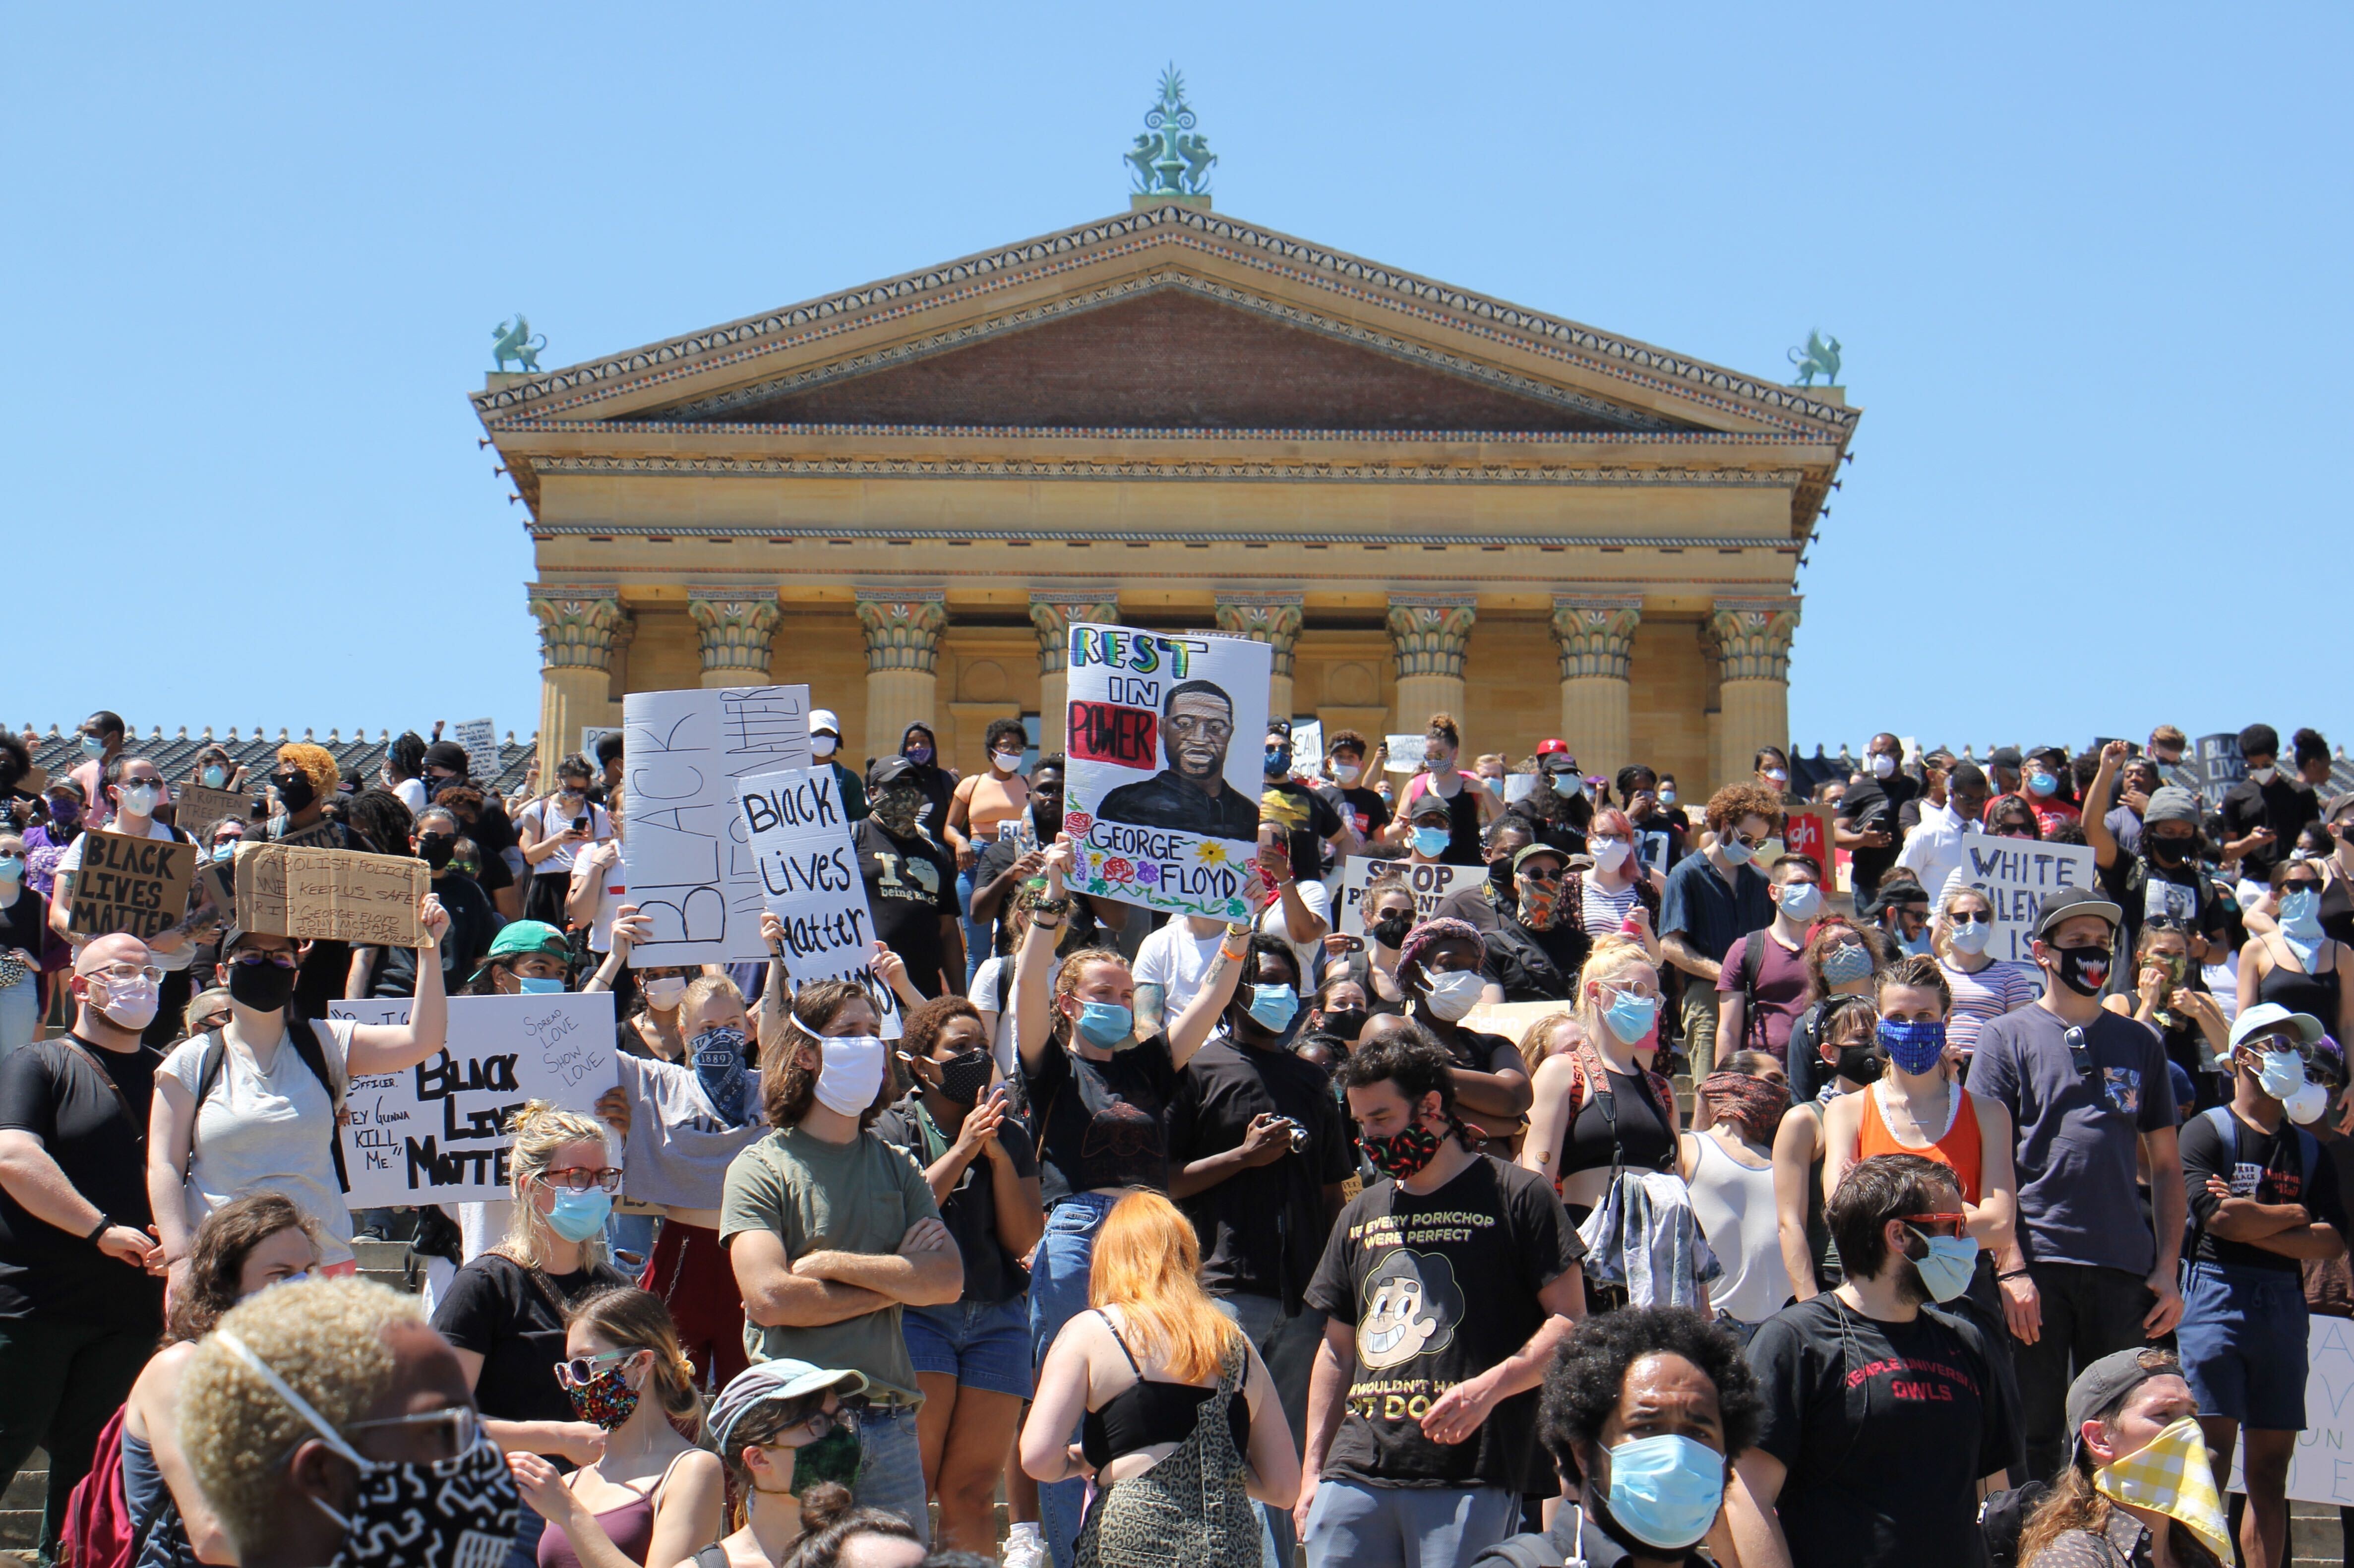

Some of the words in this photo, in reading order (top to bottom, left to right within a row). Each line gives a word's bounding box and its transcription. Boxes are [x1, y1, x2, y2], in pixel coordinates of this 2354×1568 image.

[1071, 627, 1208, 679] REST
[1108, 676, 1159, 707] IN
[1069, 701, 1153, 762] POWER
[2205, 737, 2243, 760] BLA
[2207, 758, 2247, 781] LIVE
[182, 788, 191, 801] A
[196, 791, 242, 808] ROTTEN
[182, 803, 214, 819] TREE
[744, 777, 838, 834] Black
[631, 713, 725, 950] BLACK
[1090, 822, 1184, 861] GEORGE
[86, 835, 176, 880] BLACK
[260, 851, 351, 873] ABOLISH
[358, 860, 414, 881] POLICE
[1969, 847, 2078, 887] WHITE
[79, 871, 163, 909] LIVES
[256, 876, 288, 897] WE
[300, 881, 339, 896] KEEP
[343, 886, 365, 896] US
[880, 887, 913, 901] being
[1160, 864, 1236, 899] FLOYD
[300, 905, 355, 919] GEORGE
[360, 912, 399, 926] FLOYD
[1970, 883, 2046, 923] ILEN
[297, 918, 334, 930] TONY
[297, 926, 365, 939] BREONNA
[371, 931, 415, 943] TAYLOR
[540, 1016, 579, 1049] LOVE
[543, 1045, 581, 1074] SHOW
[562, 1051, 605, 1087] LOVE
[701, 1054, 726, 1064] 1889
[416, 1047, 519, 1102] BLACK
[355, 1129, 398, 1148] KILL
[405, 1135, 514, 1190] MATTE
[1365, 1215, 1408, 1234] EVERY
[1412, 1211, 1495, 1227] PORKCHOP
[1364, 1231, 1404, 1250] WERE
[1407, 1228, 1472, 1244] PERFECT
[1891, 1380, 1953, 1401] OWLS
